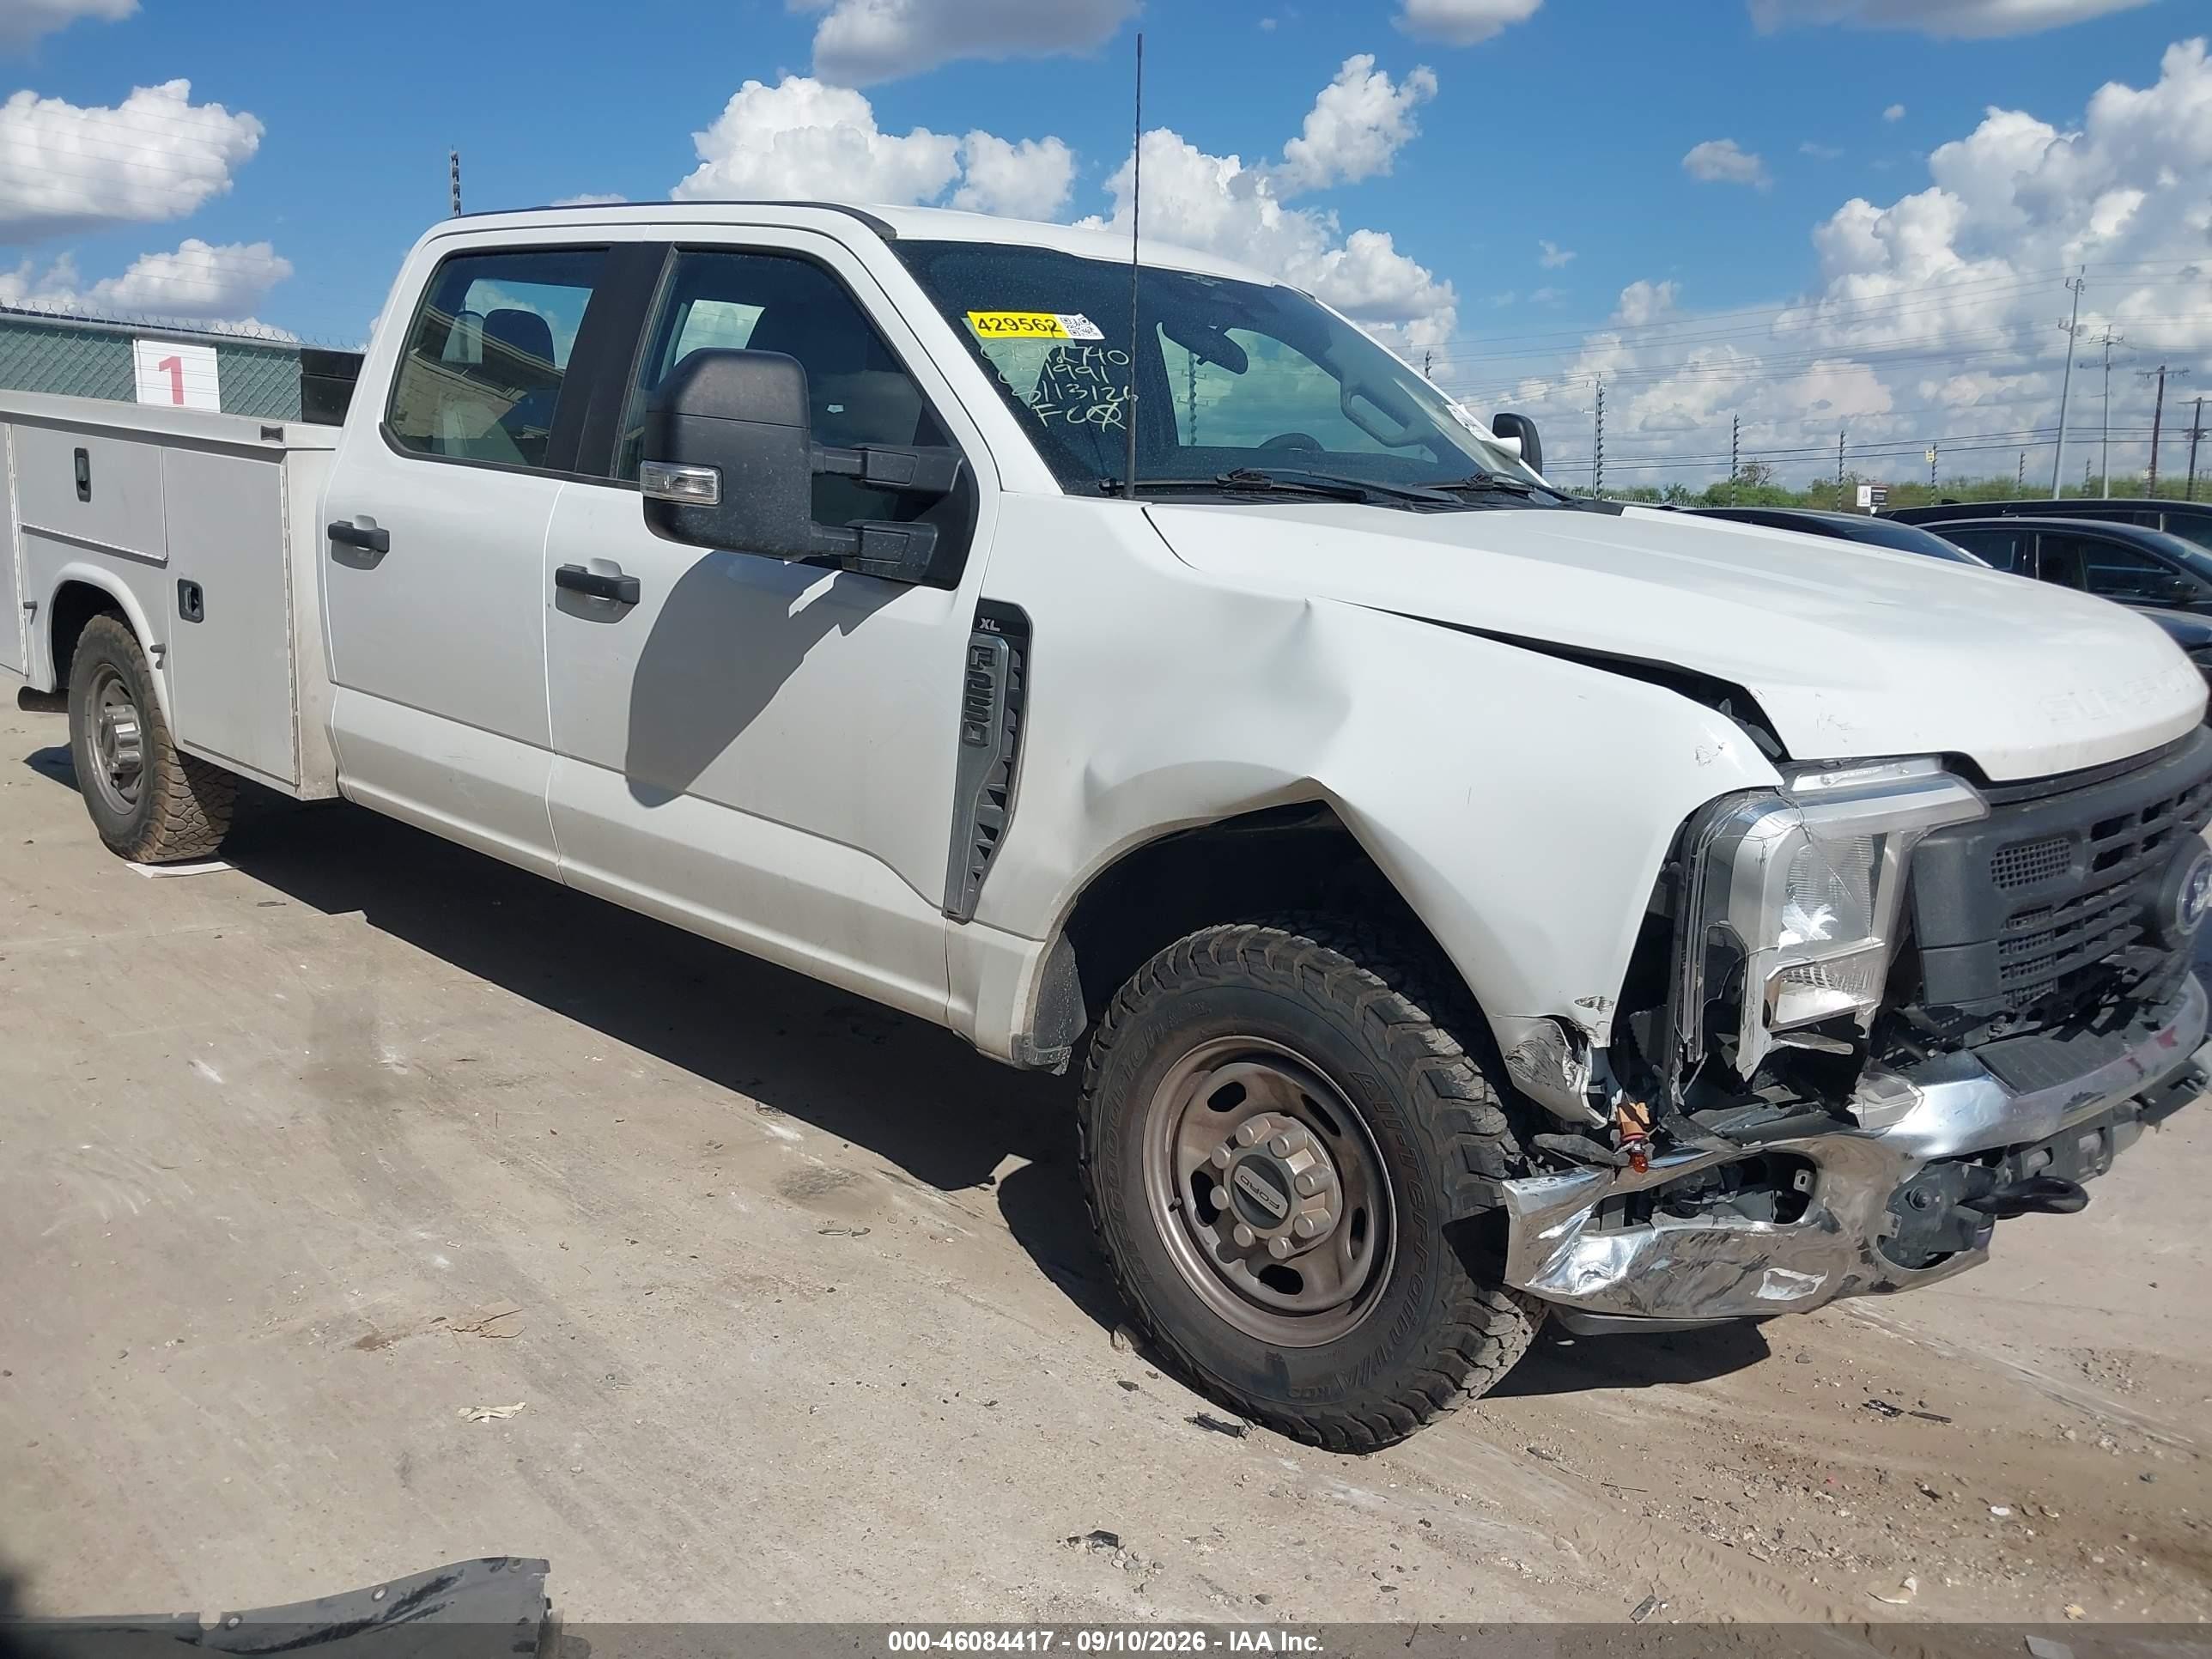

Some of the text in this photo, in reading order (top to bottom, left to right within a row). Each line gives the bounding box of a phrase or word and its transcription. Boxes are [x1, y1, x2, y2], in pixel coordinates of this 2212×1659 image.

[978, 317, 1062, 337] 429562
[158, 356, 184, 406] 1
[979, 617, 1000, 632] XL
[1240, 1174, 1279, 1209] FORD
